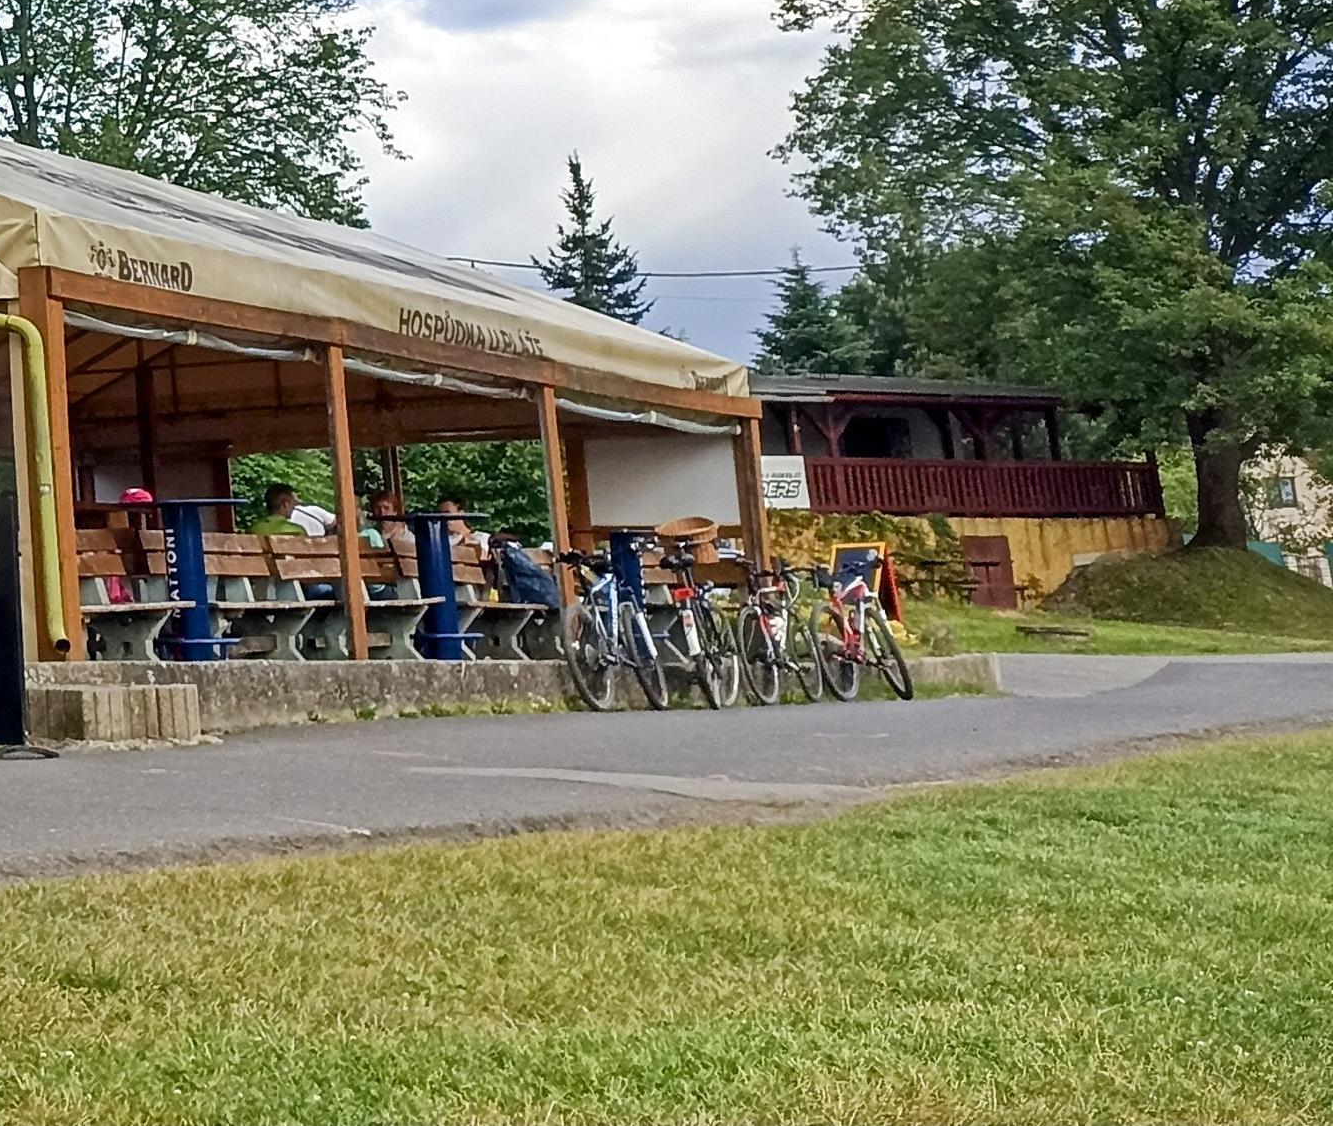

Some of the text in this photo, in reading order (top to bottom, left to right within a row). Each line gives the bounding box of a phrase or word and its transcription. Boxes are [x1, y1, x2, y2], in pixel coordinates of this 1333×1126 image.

[116, 249, 193, 292] BERNARD
[398, 307, 485, 349] HOSPŮDKA
[489, 327, 501, 352] U
